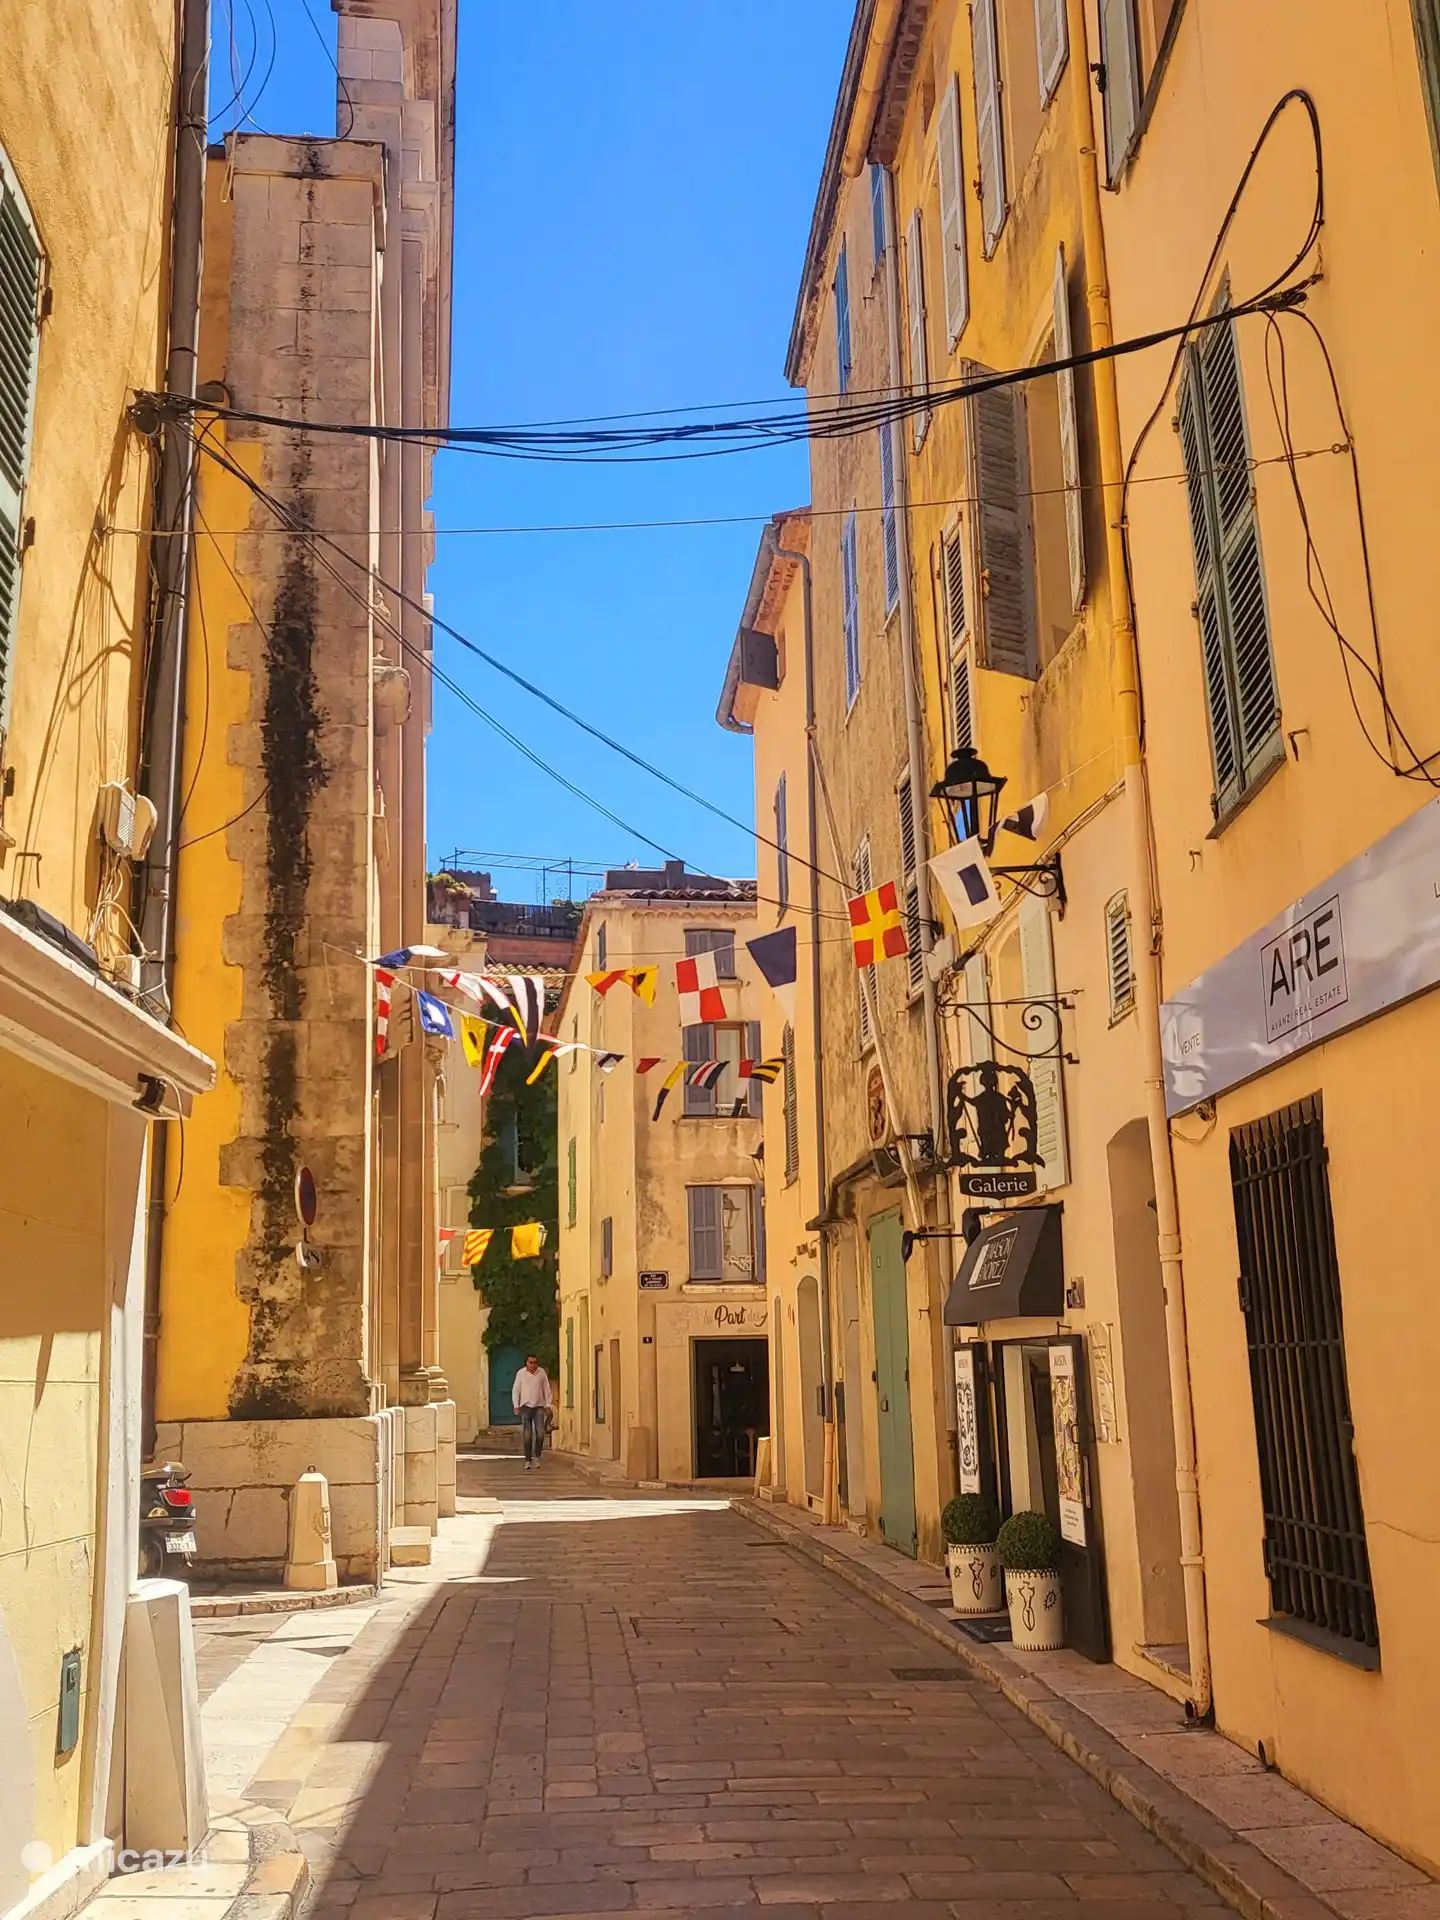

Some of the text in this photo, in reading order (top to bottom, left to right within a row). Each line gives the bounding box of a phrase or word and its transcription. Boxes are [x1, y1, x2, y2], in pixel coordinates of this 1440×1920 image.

[1269, 909, 1339, 1006] ARE
[1271, 985, 1342, 1032] AVANZI REAL ESTATE
[968, 1177, 1028, 1193] Galerie
[714, 1304, 746, 1328] Part
